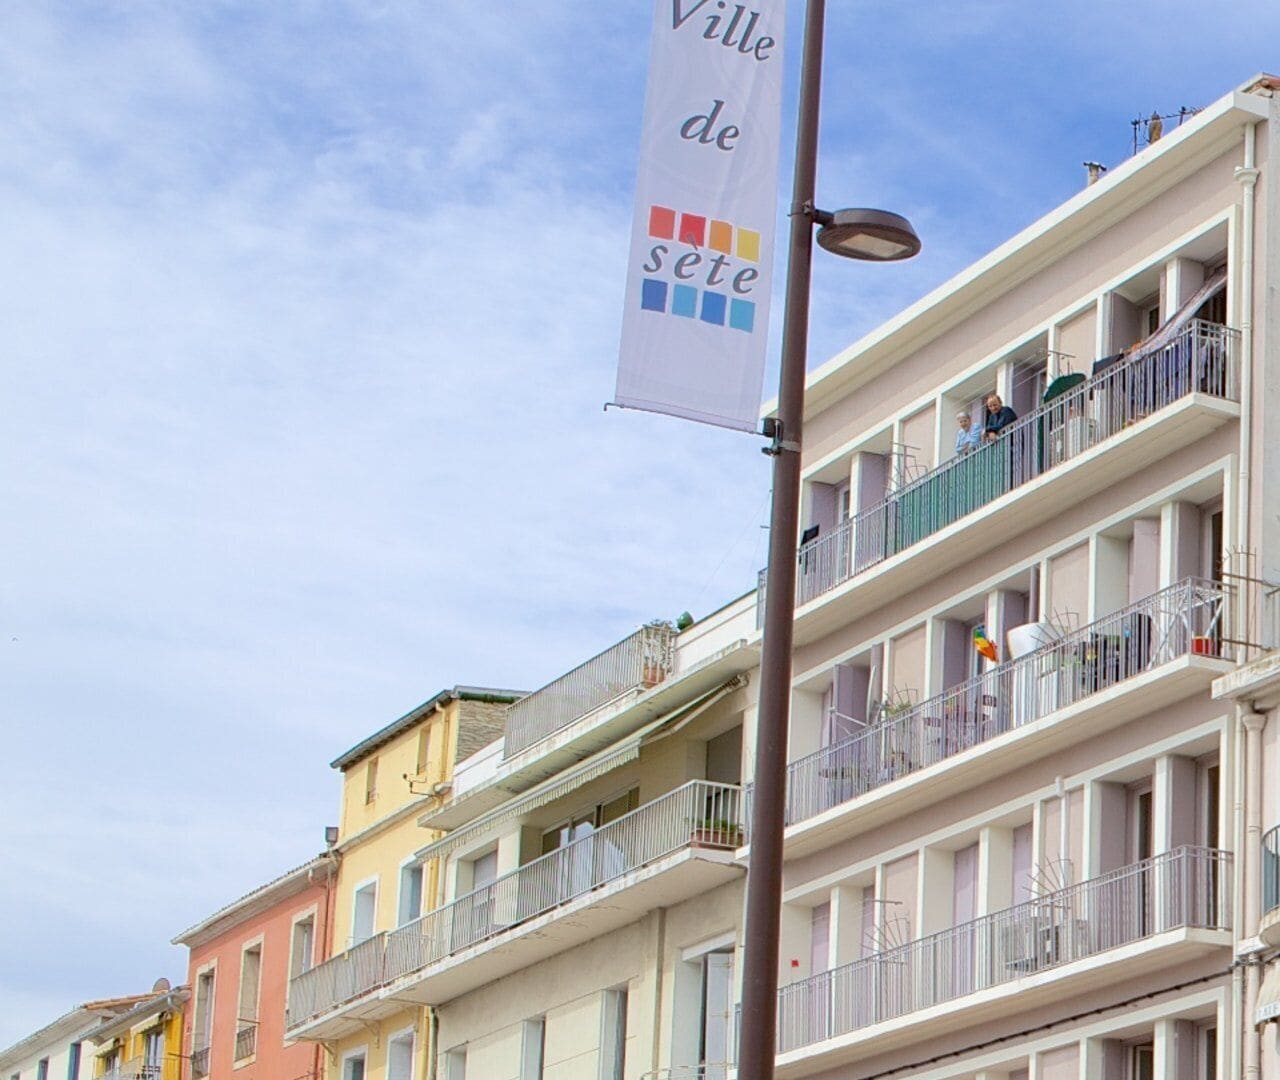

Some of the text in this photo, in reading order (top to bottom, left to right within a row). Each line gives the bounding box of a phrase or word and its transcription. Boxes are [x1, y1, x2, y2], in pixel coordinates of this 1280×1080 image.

[670, 0, 775, 61] Ville
[680, 99, 740, 151] de
[643, 233, 759, 294] sète
